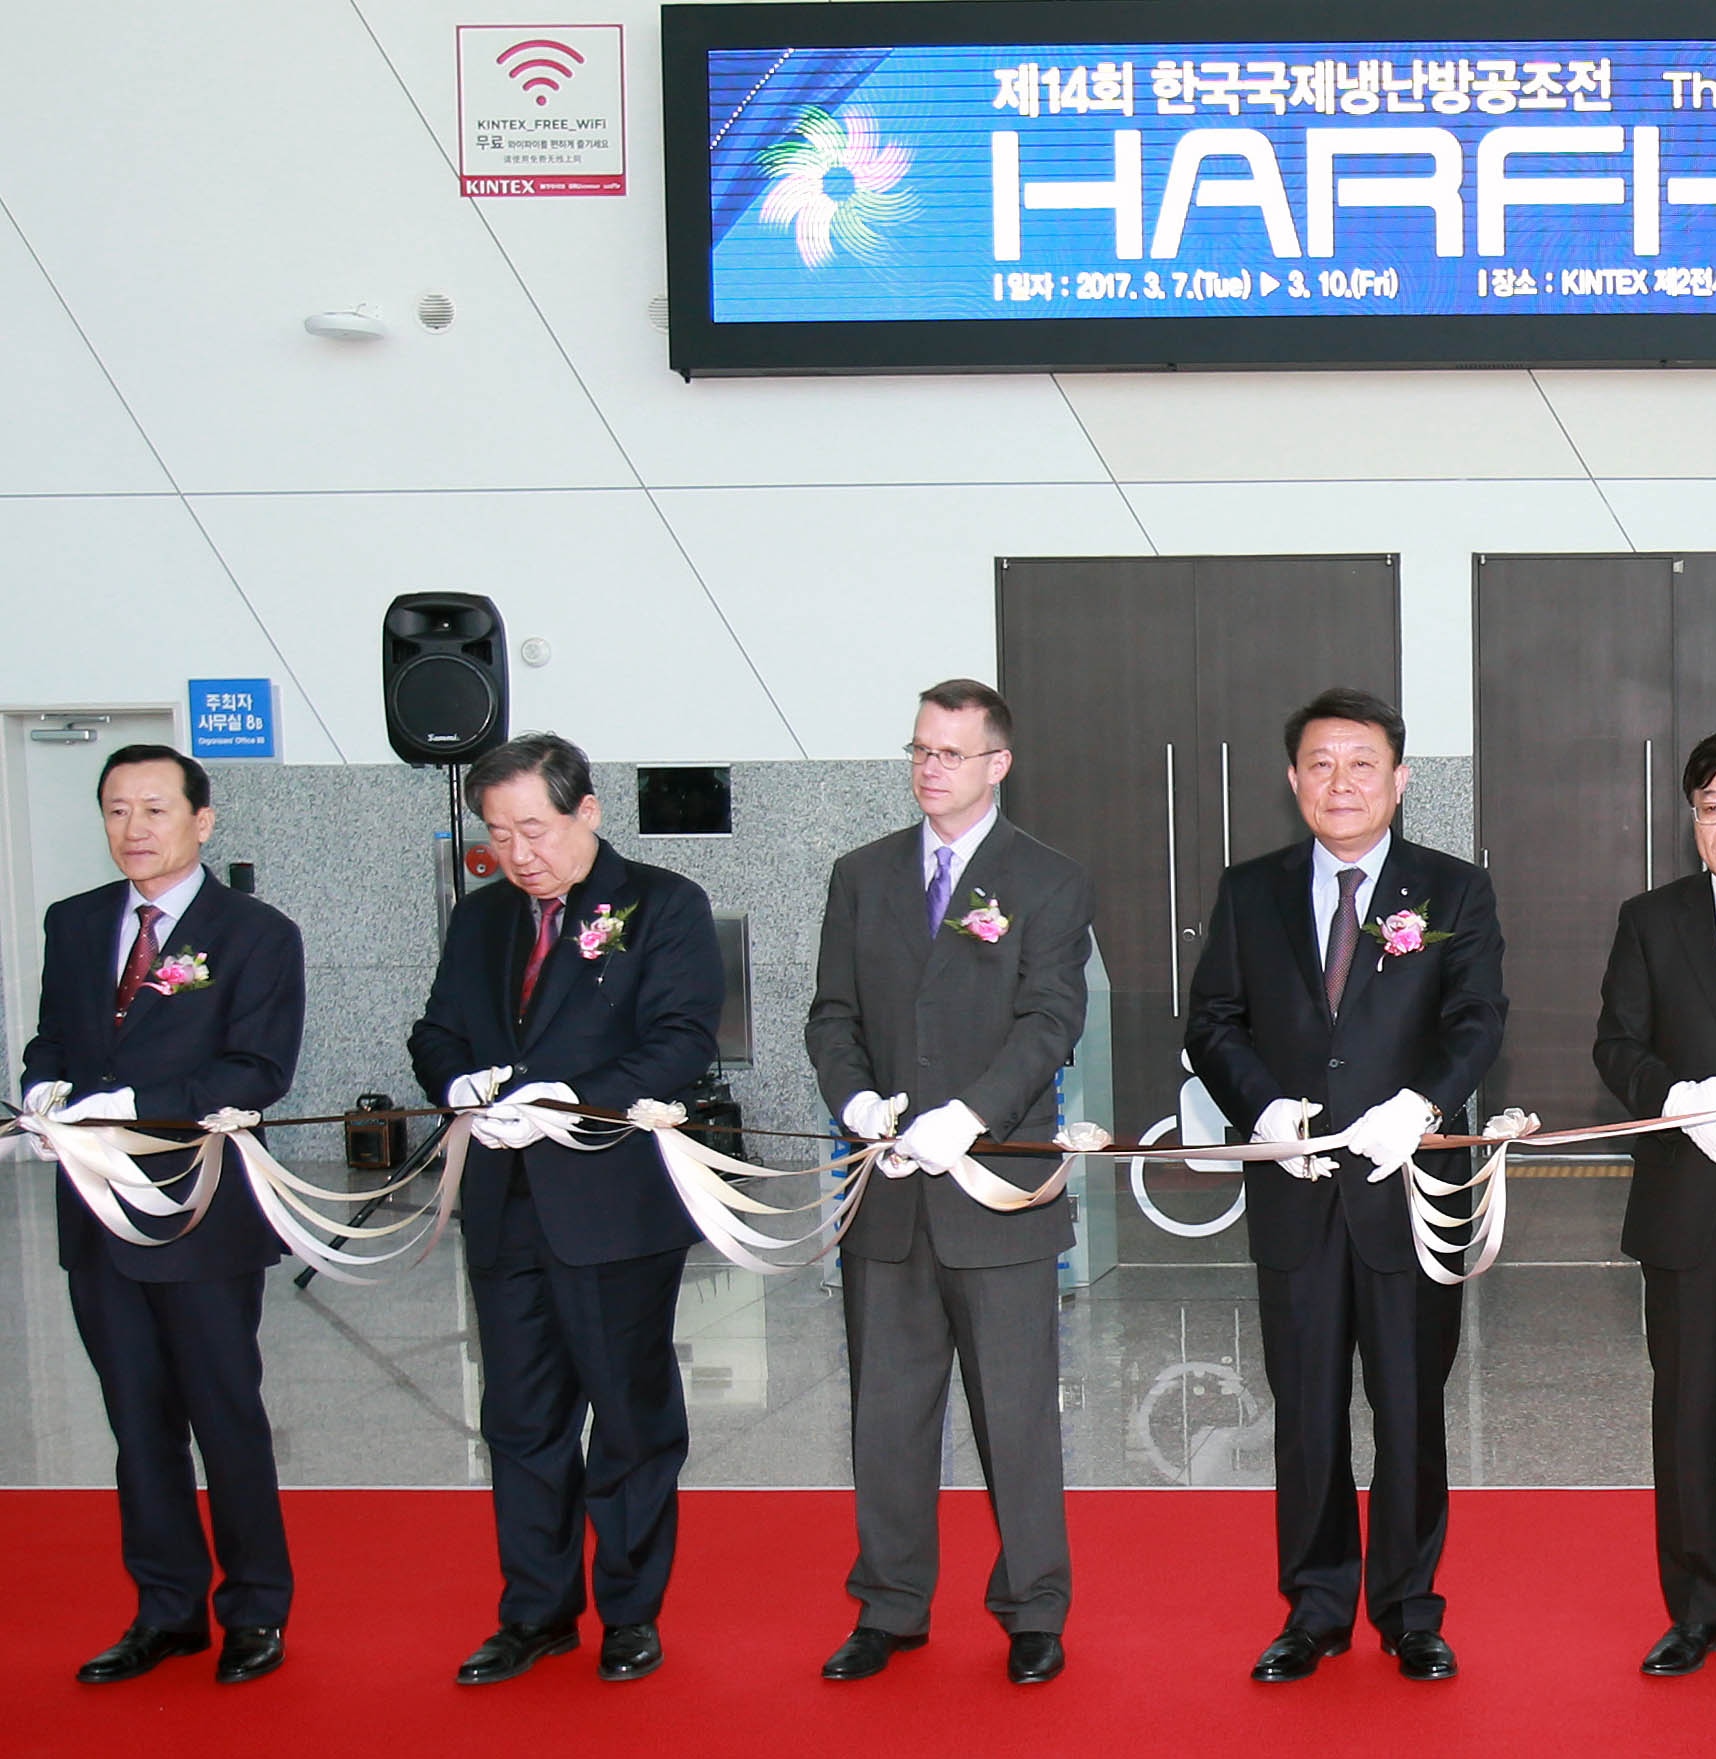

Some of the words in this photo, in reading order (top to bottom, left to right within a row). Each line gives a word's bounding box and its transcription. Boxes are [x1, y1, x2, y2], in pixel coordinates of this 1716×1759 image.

[994, 61, 1133, 118] 제14회
[1150, 57, 1612, 116] 한국국제냉난방공조전
[476, 135, 504, 150] 무료
[466, 180, 536, 194] KINTEX
[1008, 269, 1055, 301] 일자
[1076, 271, 1139, 300] 2017.
[1492, 267, 1538, 297] 장소
[1561, 267, 1650, 296] KINTEX
[206, 693, 254, 712] 주최자
[198, 713, 242, 732] 사무실
